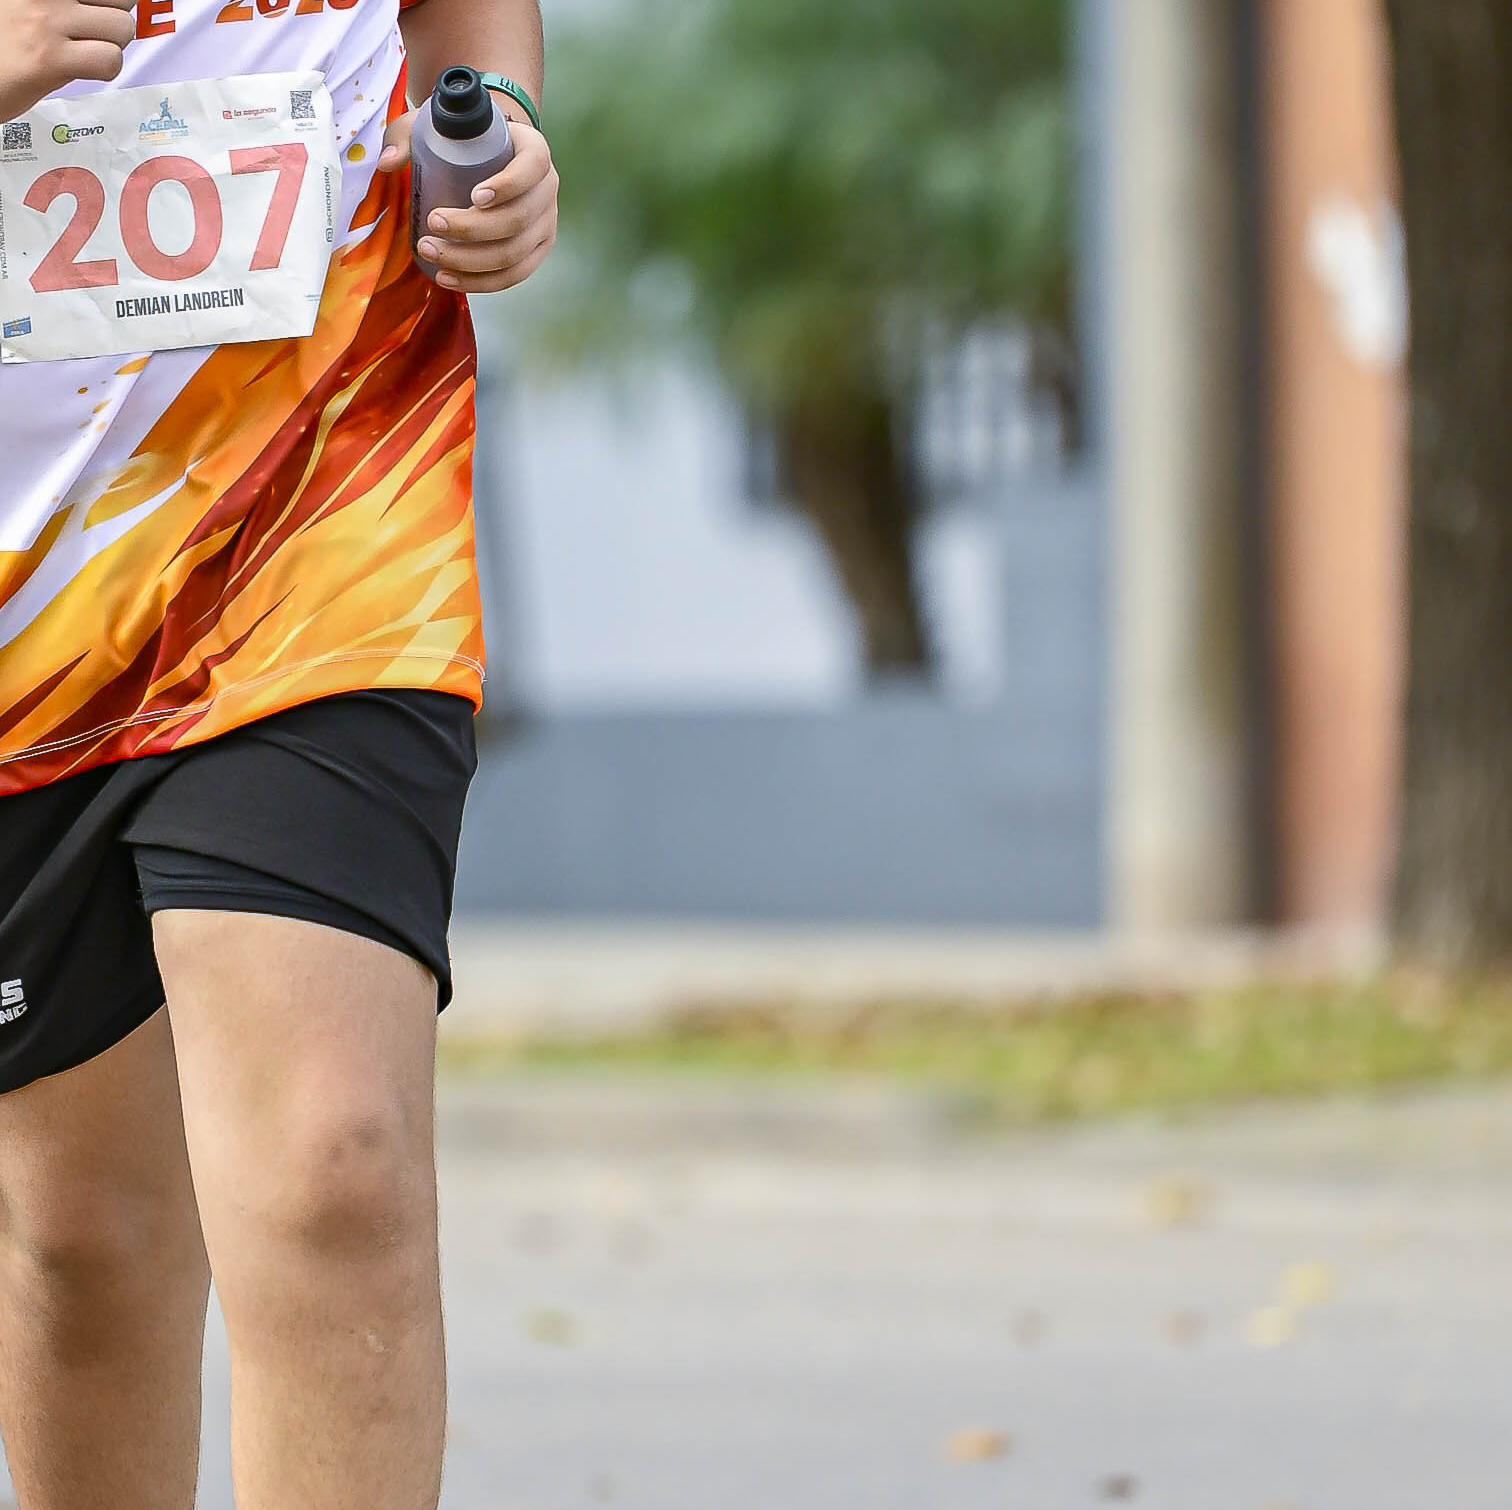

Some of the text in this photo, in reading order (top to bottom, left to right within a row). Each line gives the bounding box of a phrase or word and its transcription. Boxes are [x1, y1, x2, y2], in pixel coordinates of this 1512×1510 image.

[23, 143, 309, 293] 207
[115, 288, 245, 318] DEMIAN LANDREIN
